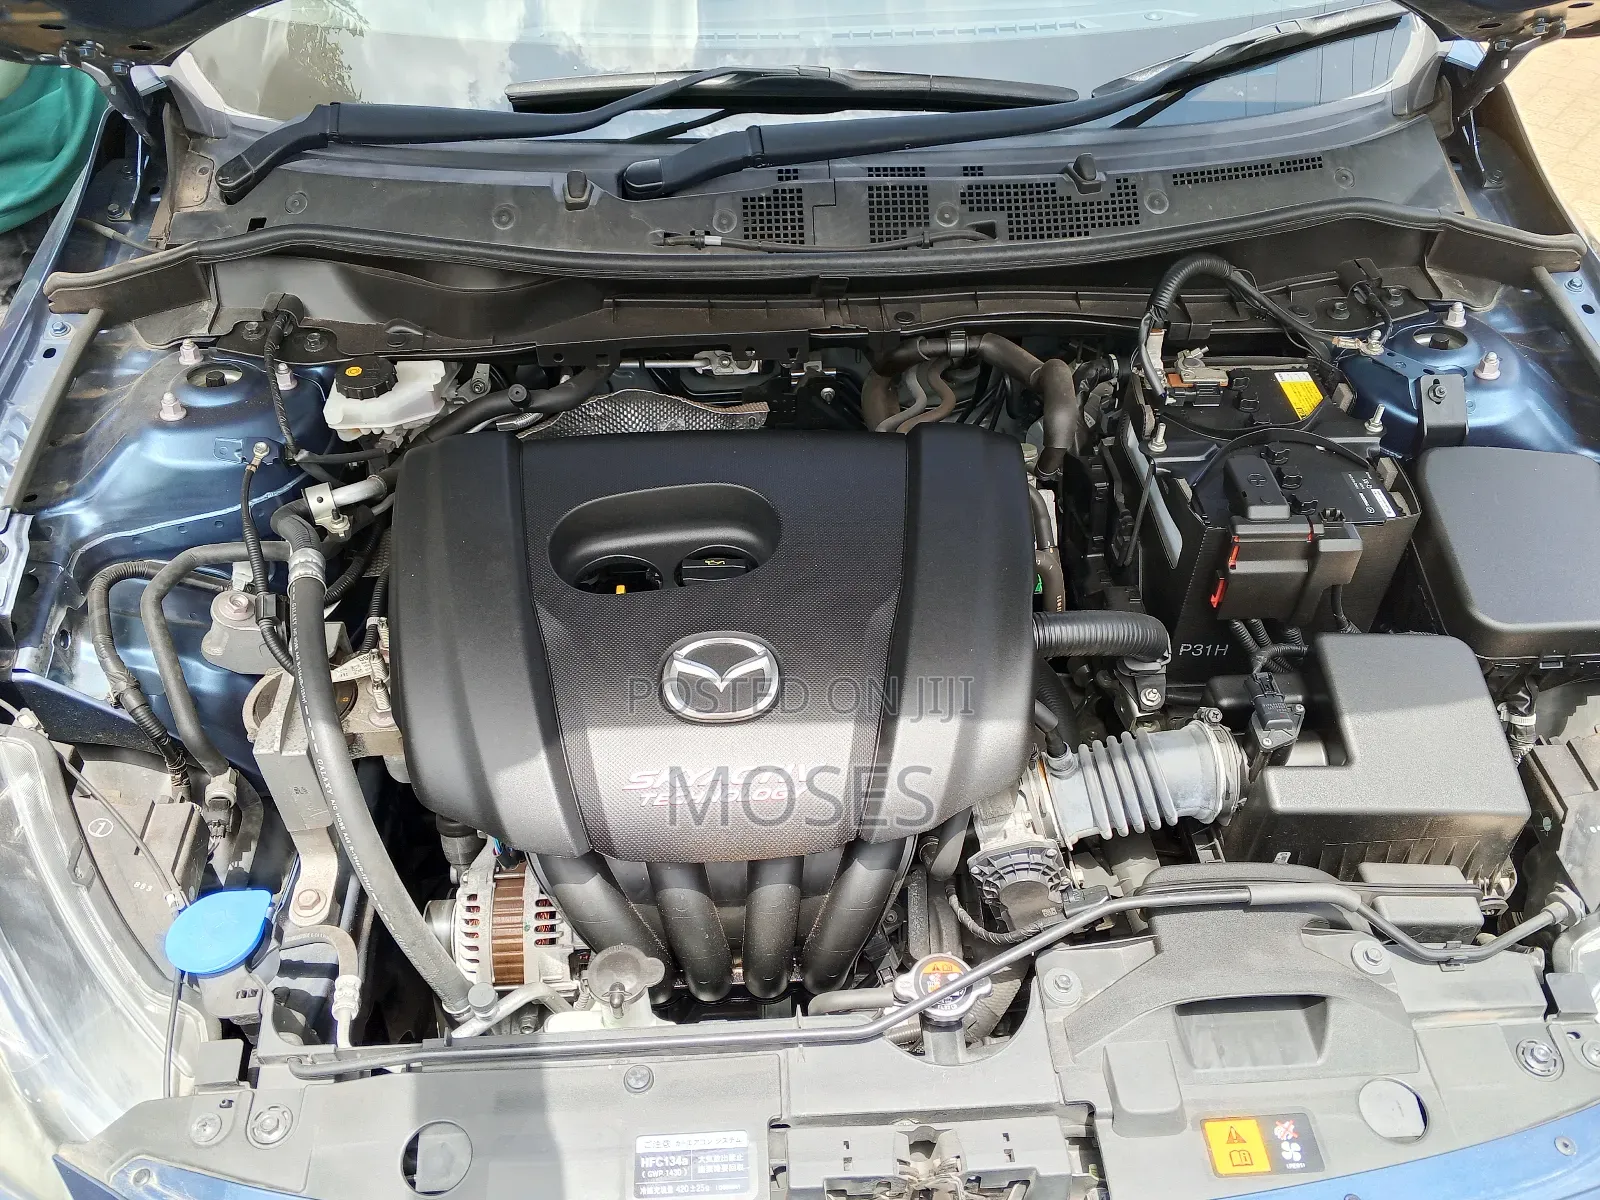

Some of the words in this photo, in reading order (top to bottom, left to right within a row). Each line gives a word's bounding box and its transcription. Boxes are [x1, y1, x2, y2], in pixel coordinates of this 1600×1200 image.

[1179, 643, 1229, 657] P31H
[316, 758, 334, 796] GALAXY
[640, 1155, 689, 1168] HFC134a
